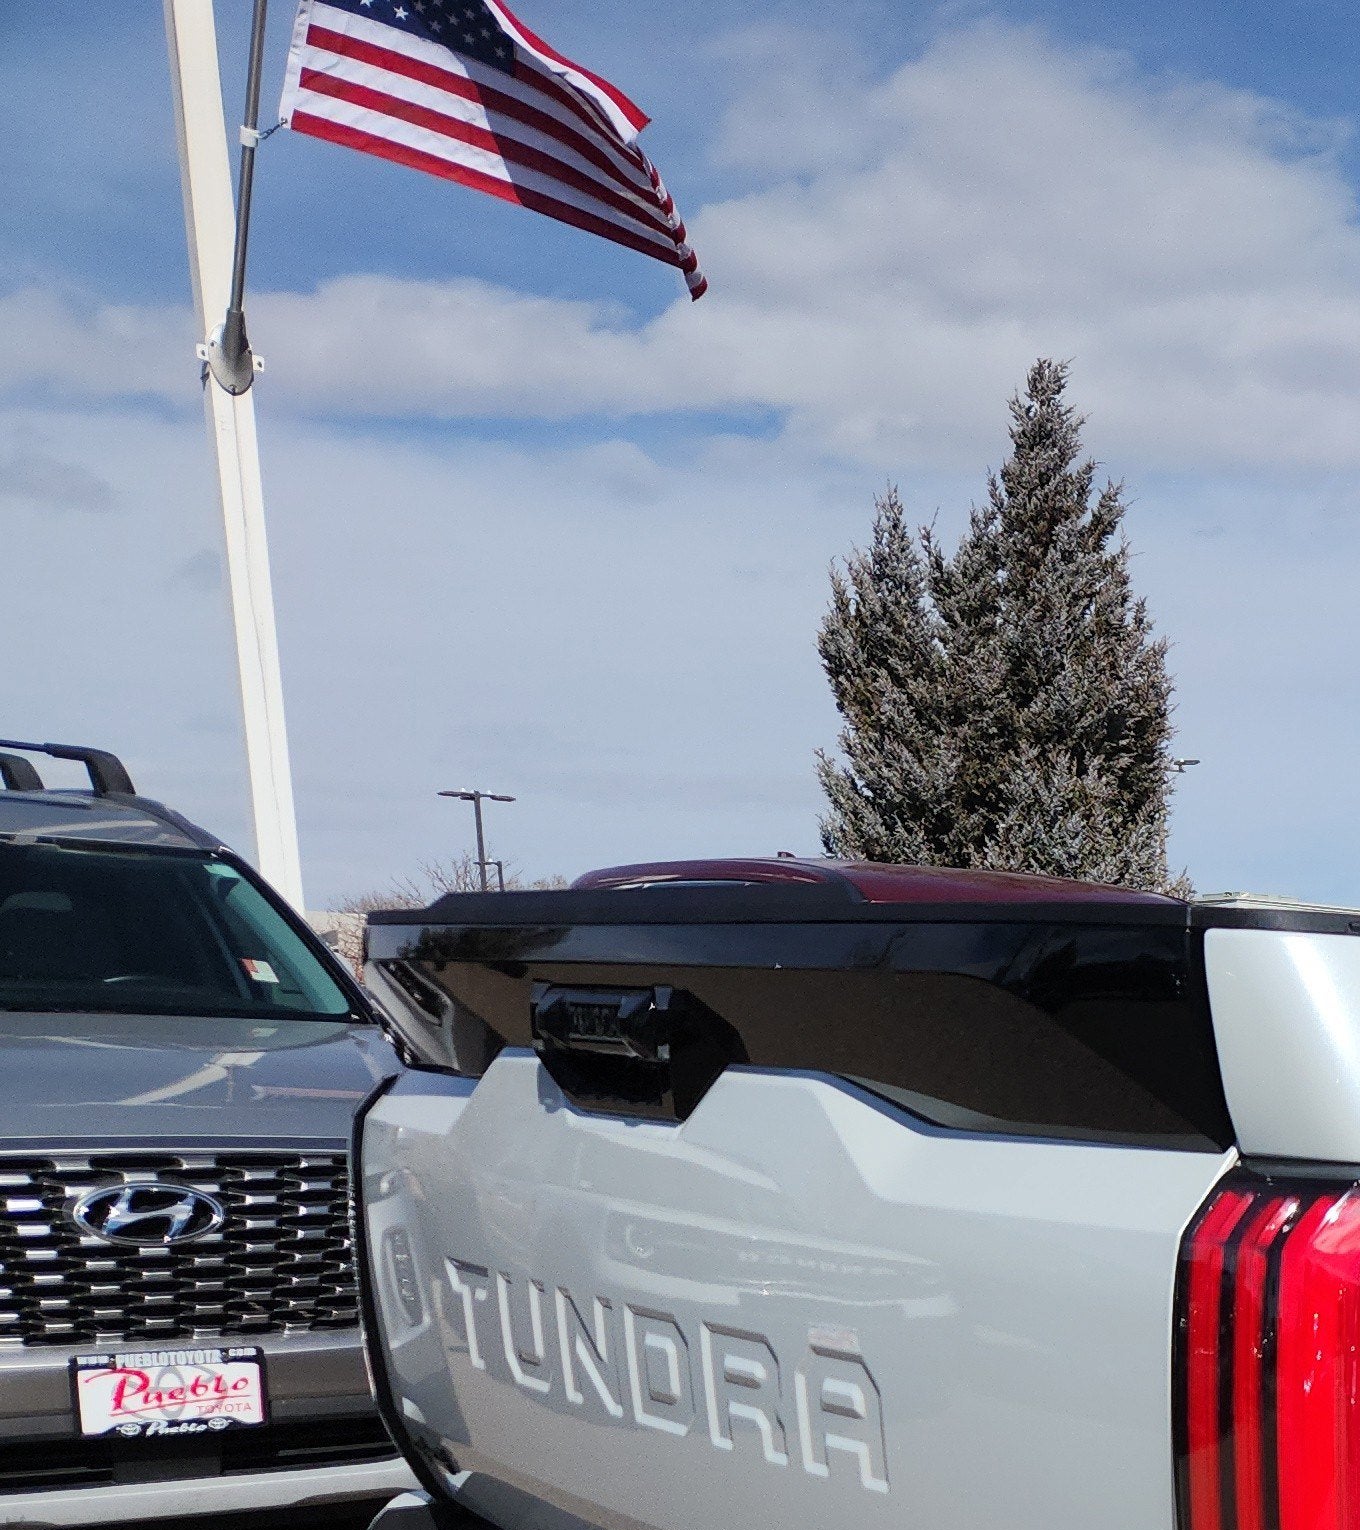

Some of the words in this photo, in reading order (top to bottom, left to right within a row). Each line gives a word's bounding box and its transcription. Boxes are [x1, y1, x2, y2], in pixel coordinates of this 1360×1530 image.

[84, 1367, 249, 1411] Pueblo
[444, 1256, 890, 1494] TUNDRA
[195, 1402, 252, 1415] TOYOTA
